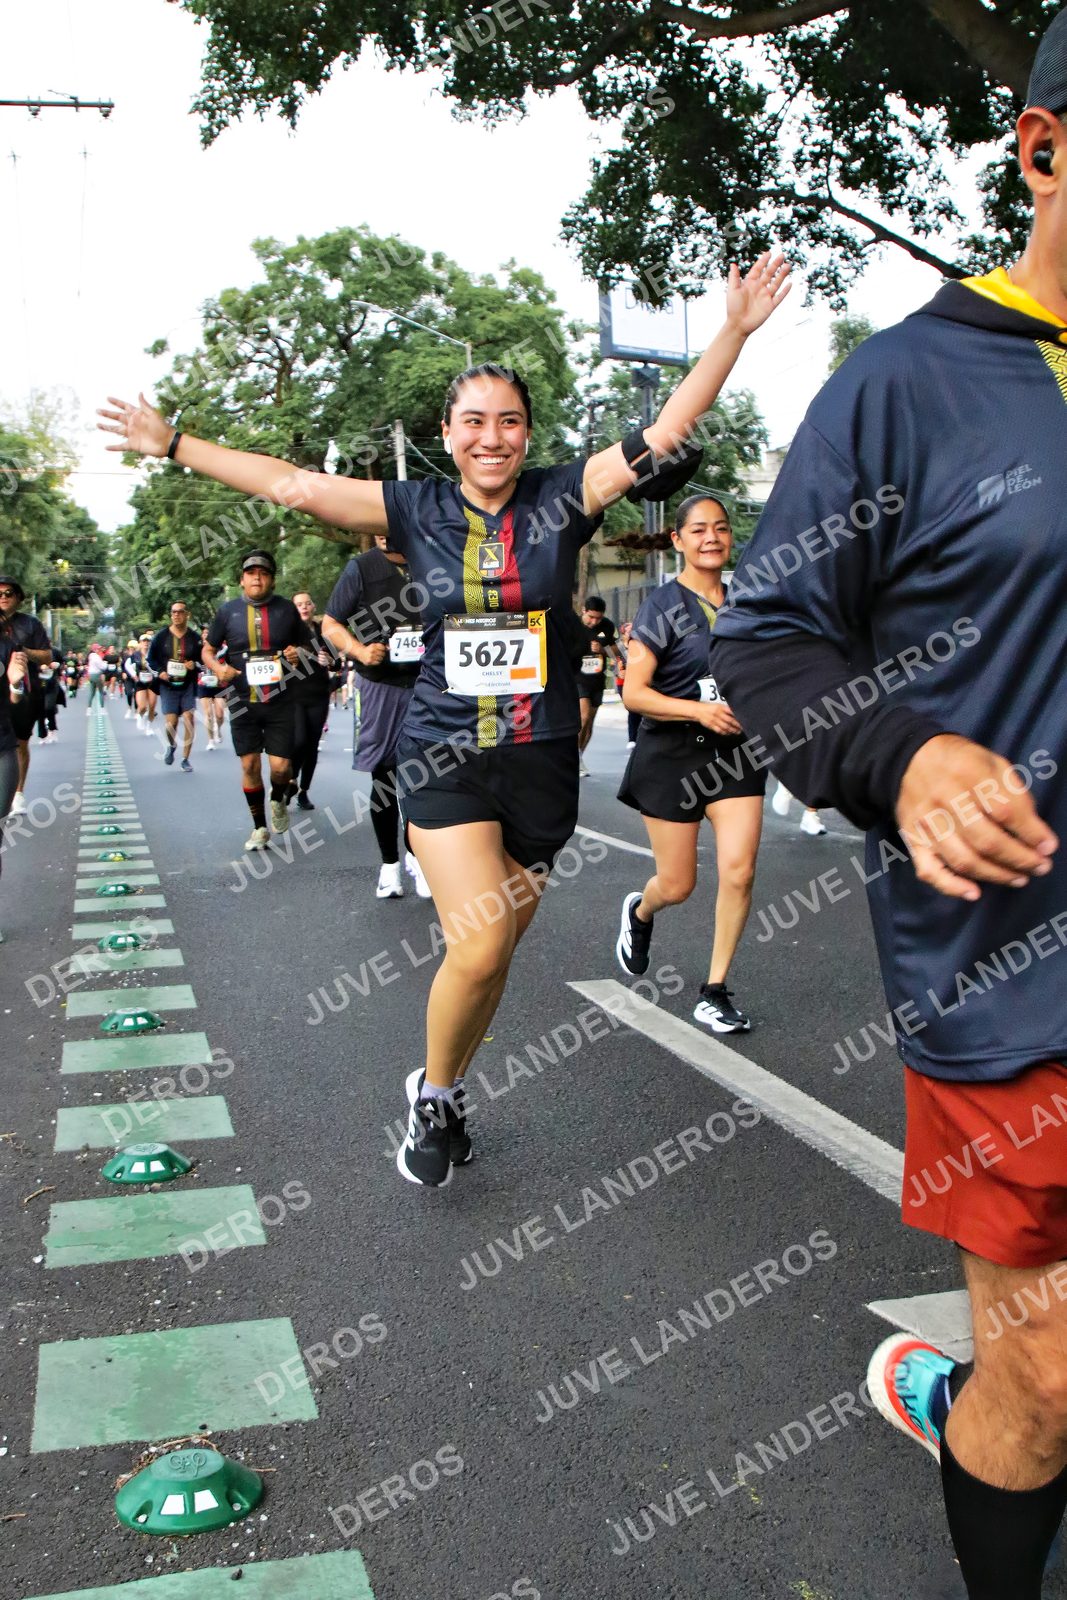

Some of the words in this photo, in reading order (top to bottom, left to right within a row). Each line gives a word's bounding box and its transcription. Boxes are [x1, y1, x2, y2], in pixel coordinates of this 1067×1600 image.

[1006, 464, 1033, 478] PIEL
[1007, 475, 1023, 486] DE
[459, 639, 525, 667] 5627
[252, 664, 275, 675] 1959
